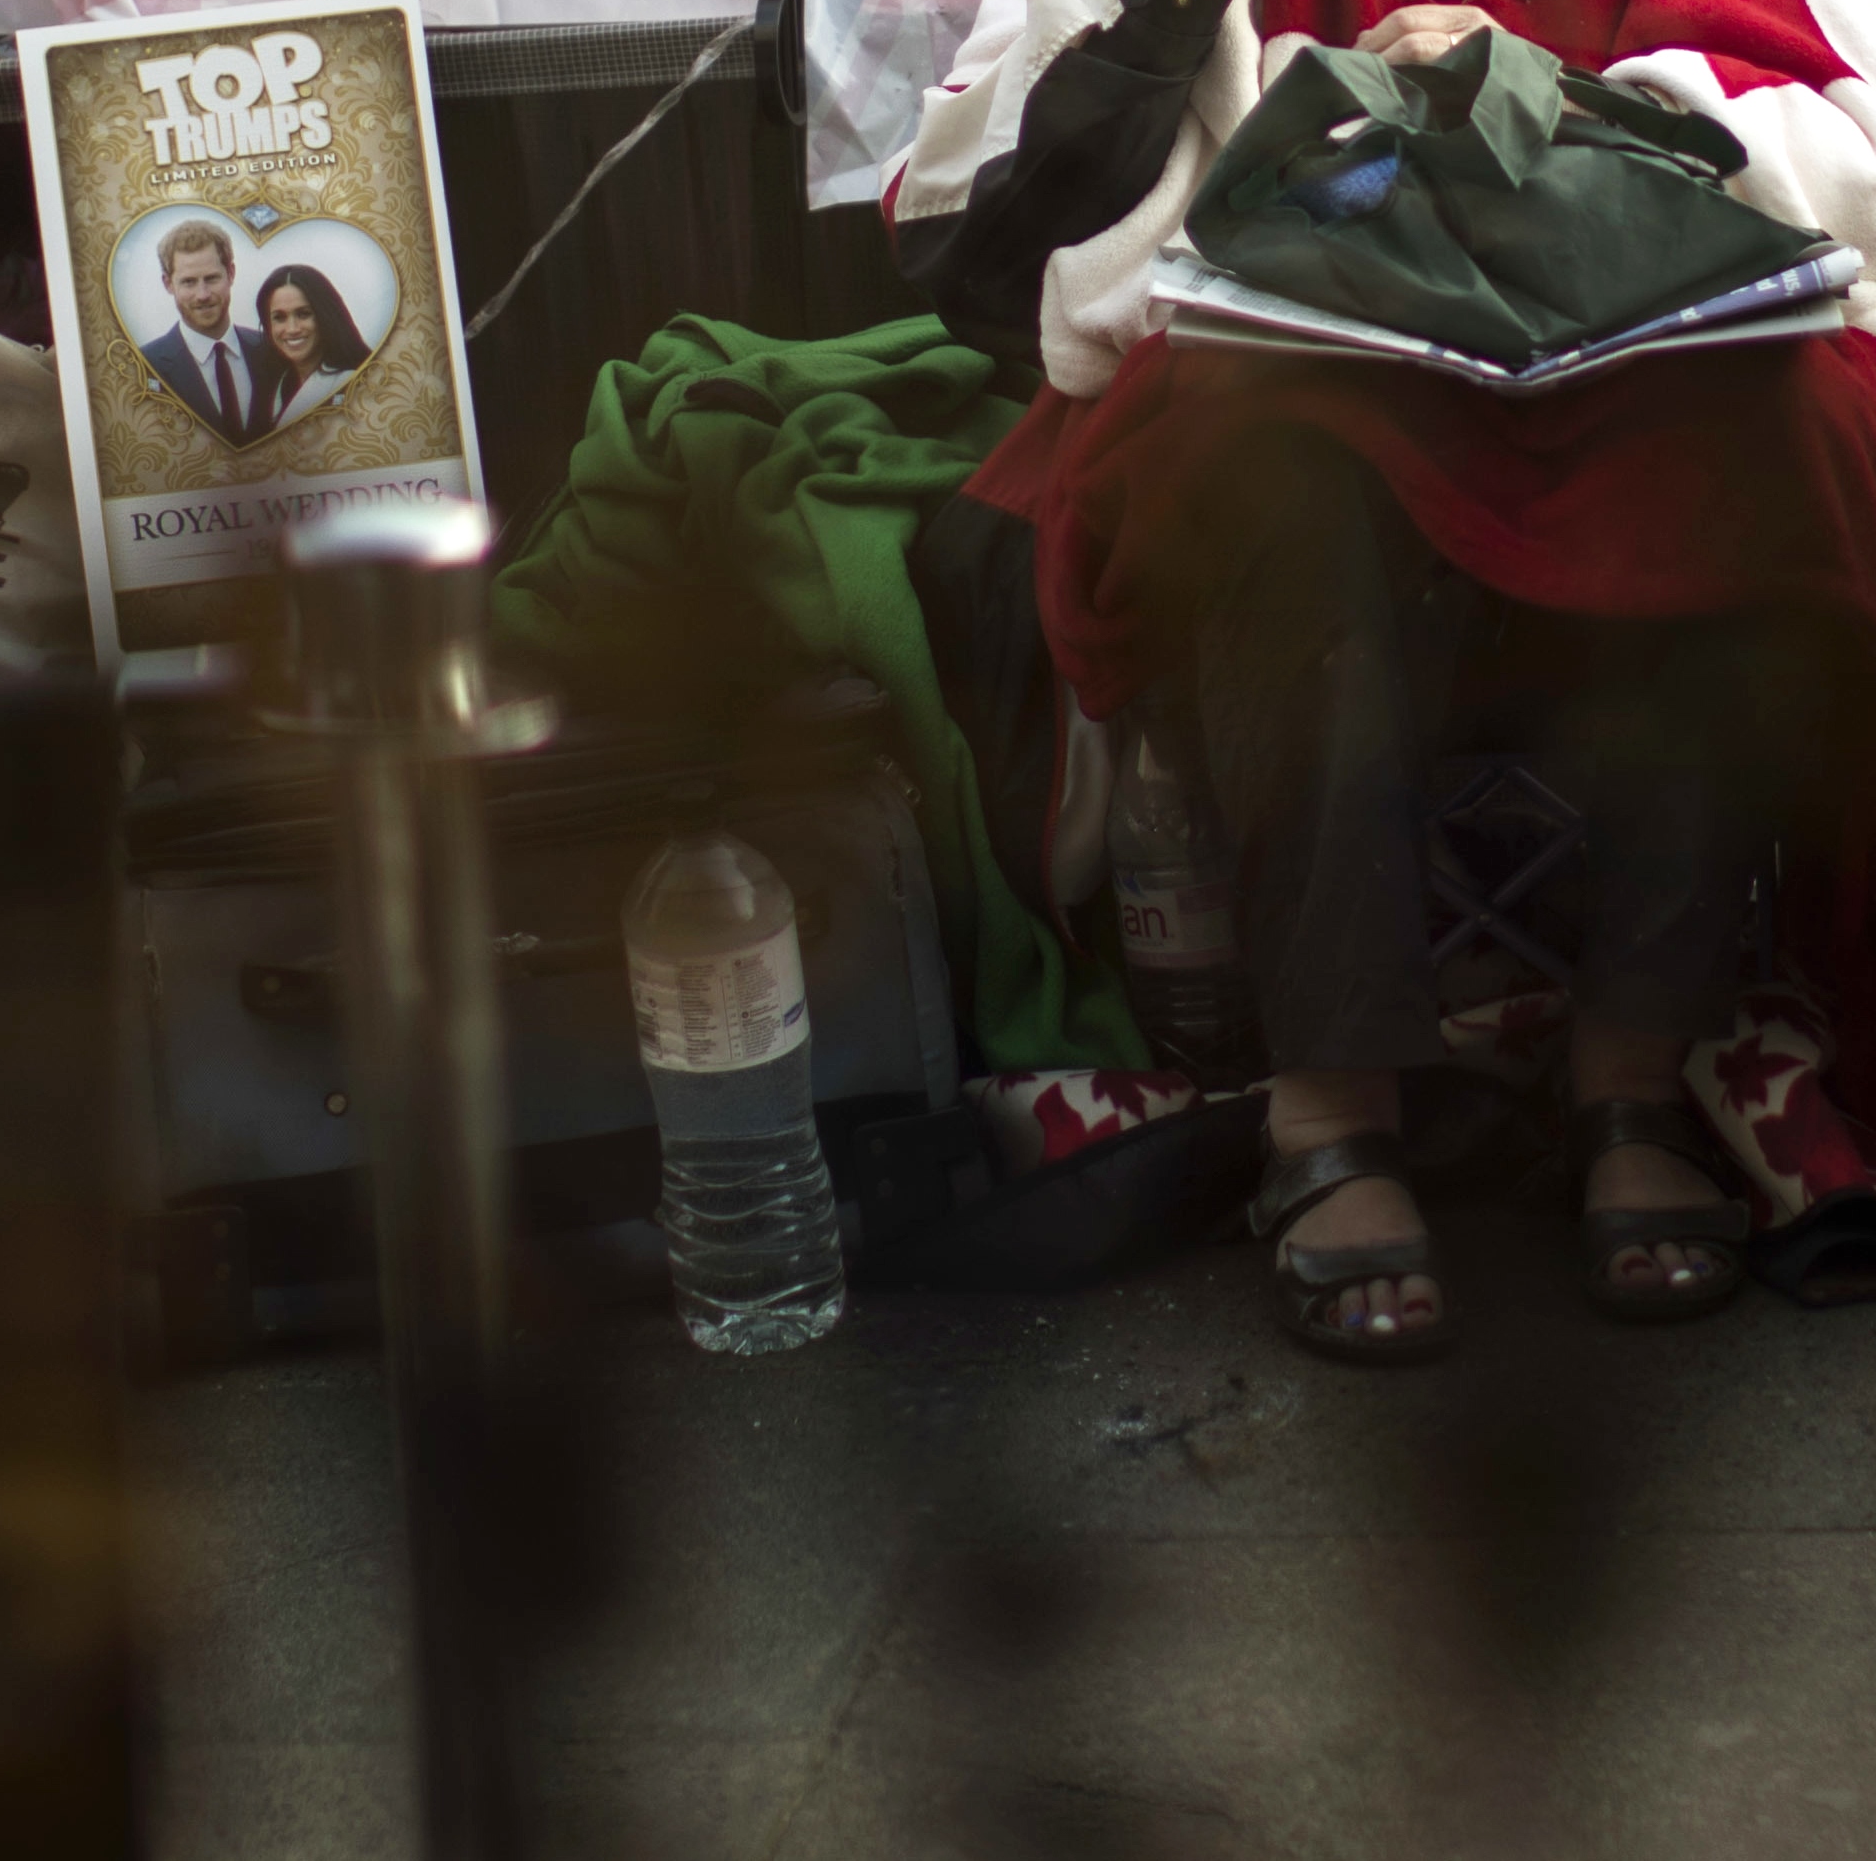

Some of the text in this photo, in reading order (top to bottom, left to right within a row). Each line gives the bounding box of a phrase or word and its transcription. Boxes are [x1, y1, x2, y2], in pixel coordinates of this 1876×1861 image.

[135, 31, 323, 118] TOP
[144, 99, 333, 167] TRUMPS
[150, 153, 337, 184] LIMITED EDITION
[131, 501, 253, 541] ROYAL
